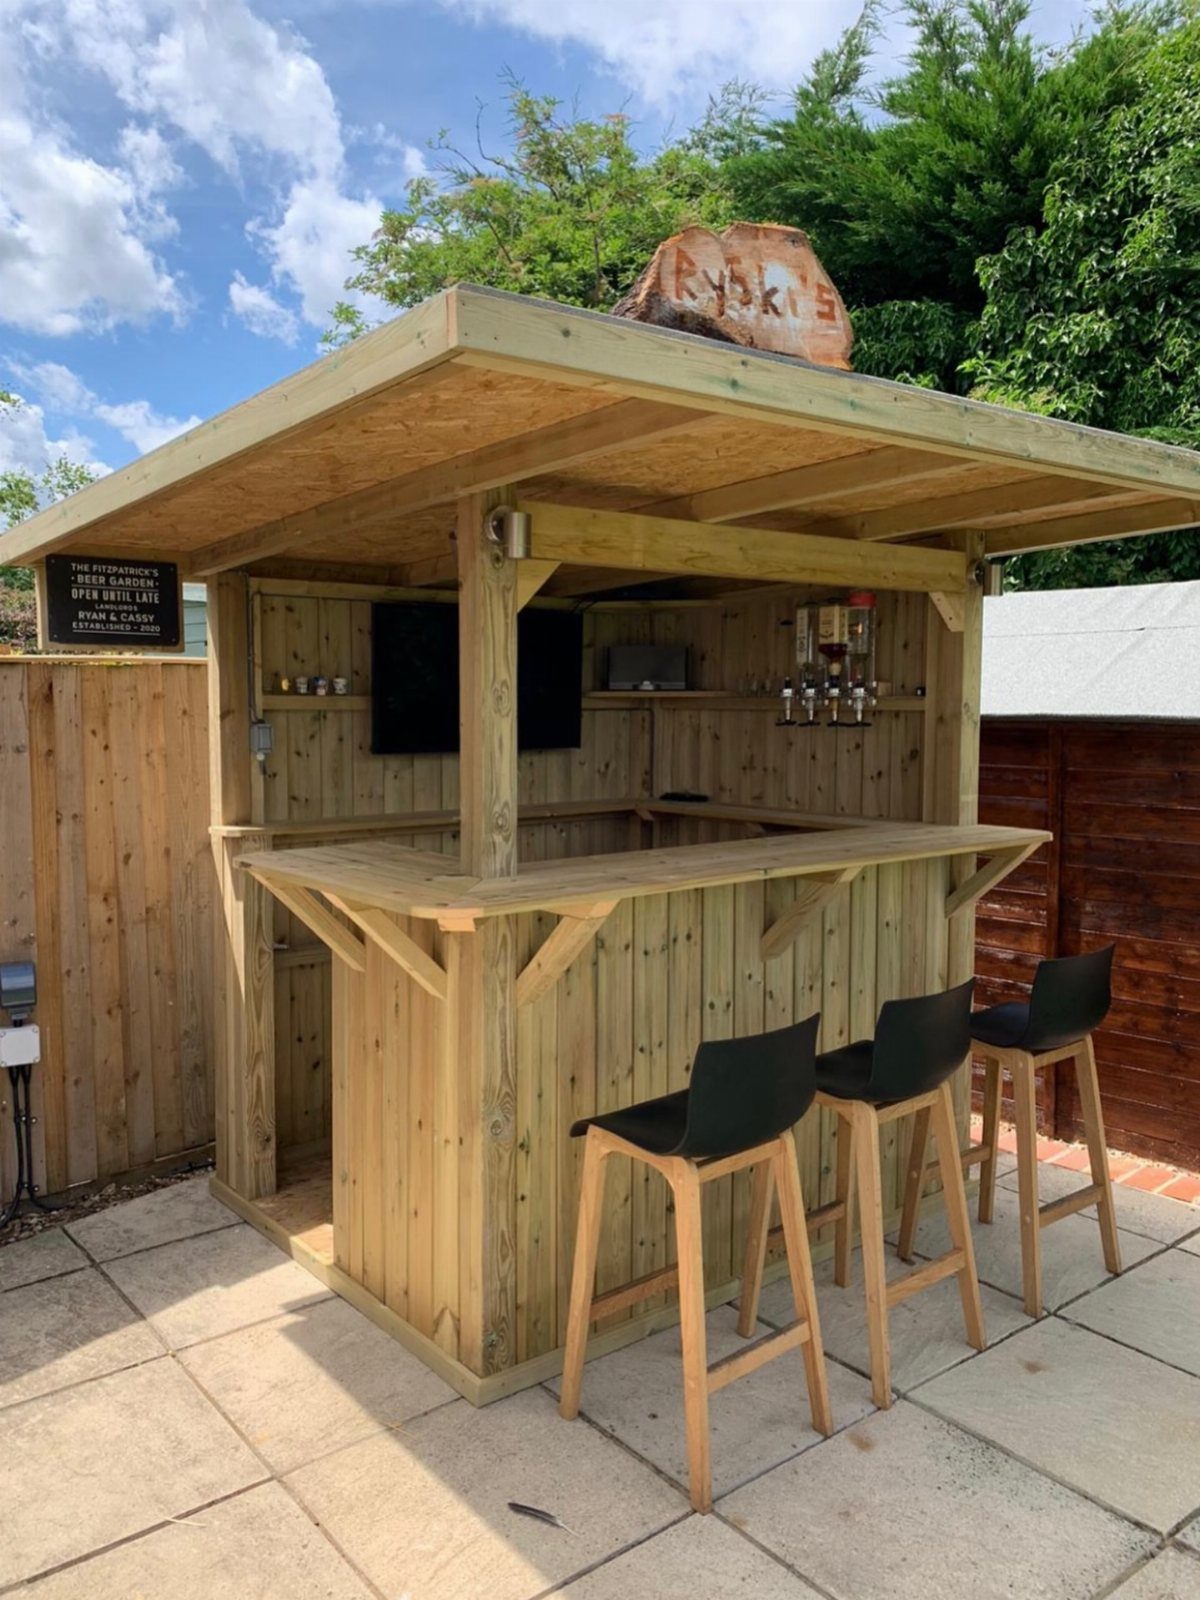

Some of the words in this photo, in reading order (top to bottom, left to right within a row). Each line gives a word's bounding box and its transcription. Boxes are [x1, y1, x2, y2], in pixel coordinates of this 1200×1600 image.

[71, 562, 90, 572] THE
[93, 564, 159, 577] FITZPATRICK'S
[77, 574, 106, 585] BEER
[109, 576, 154, 588] GARDEN
[71, 588, 99, 600] OPEN
[102, 589, 132, 602] UNTIL
[136, 591, 160, 604] LATE
[78, 611, 106, 620] RYAN
[120, 613, 155, 623] CASSY
[72, 621, 131, 632] ESTABLISHED
[140, 625, 161, 633] 2020
